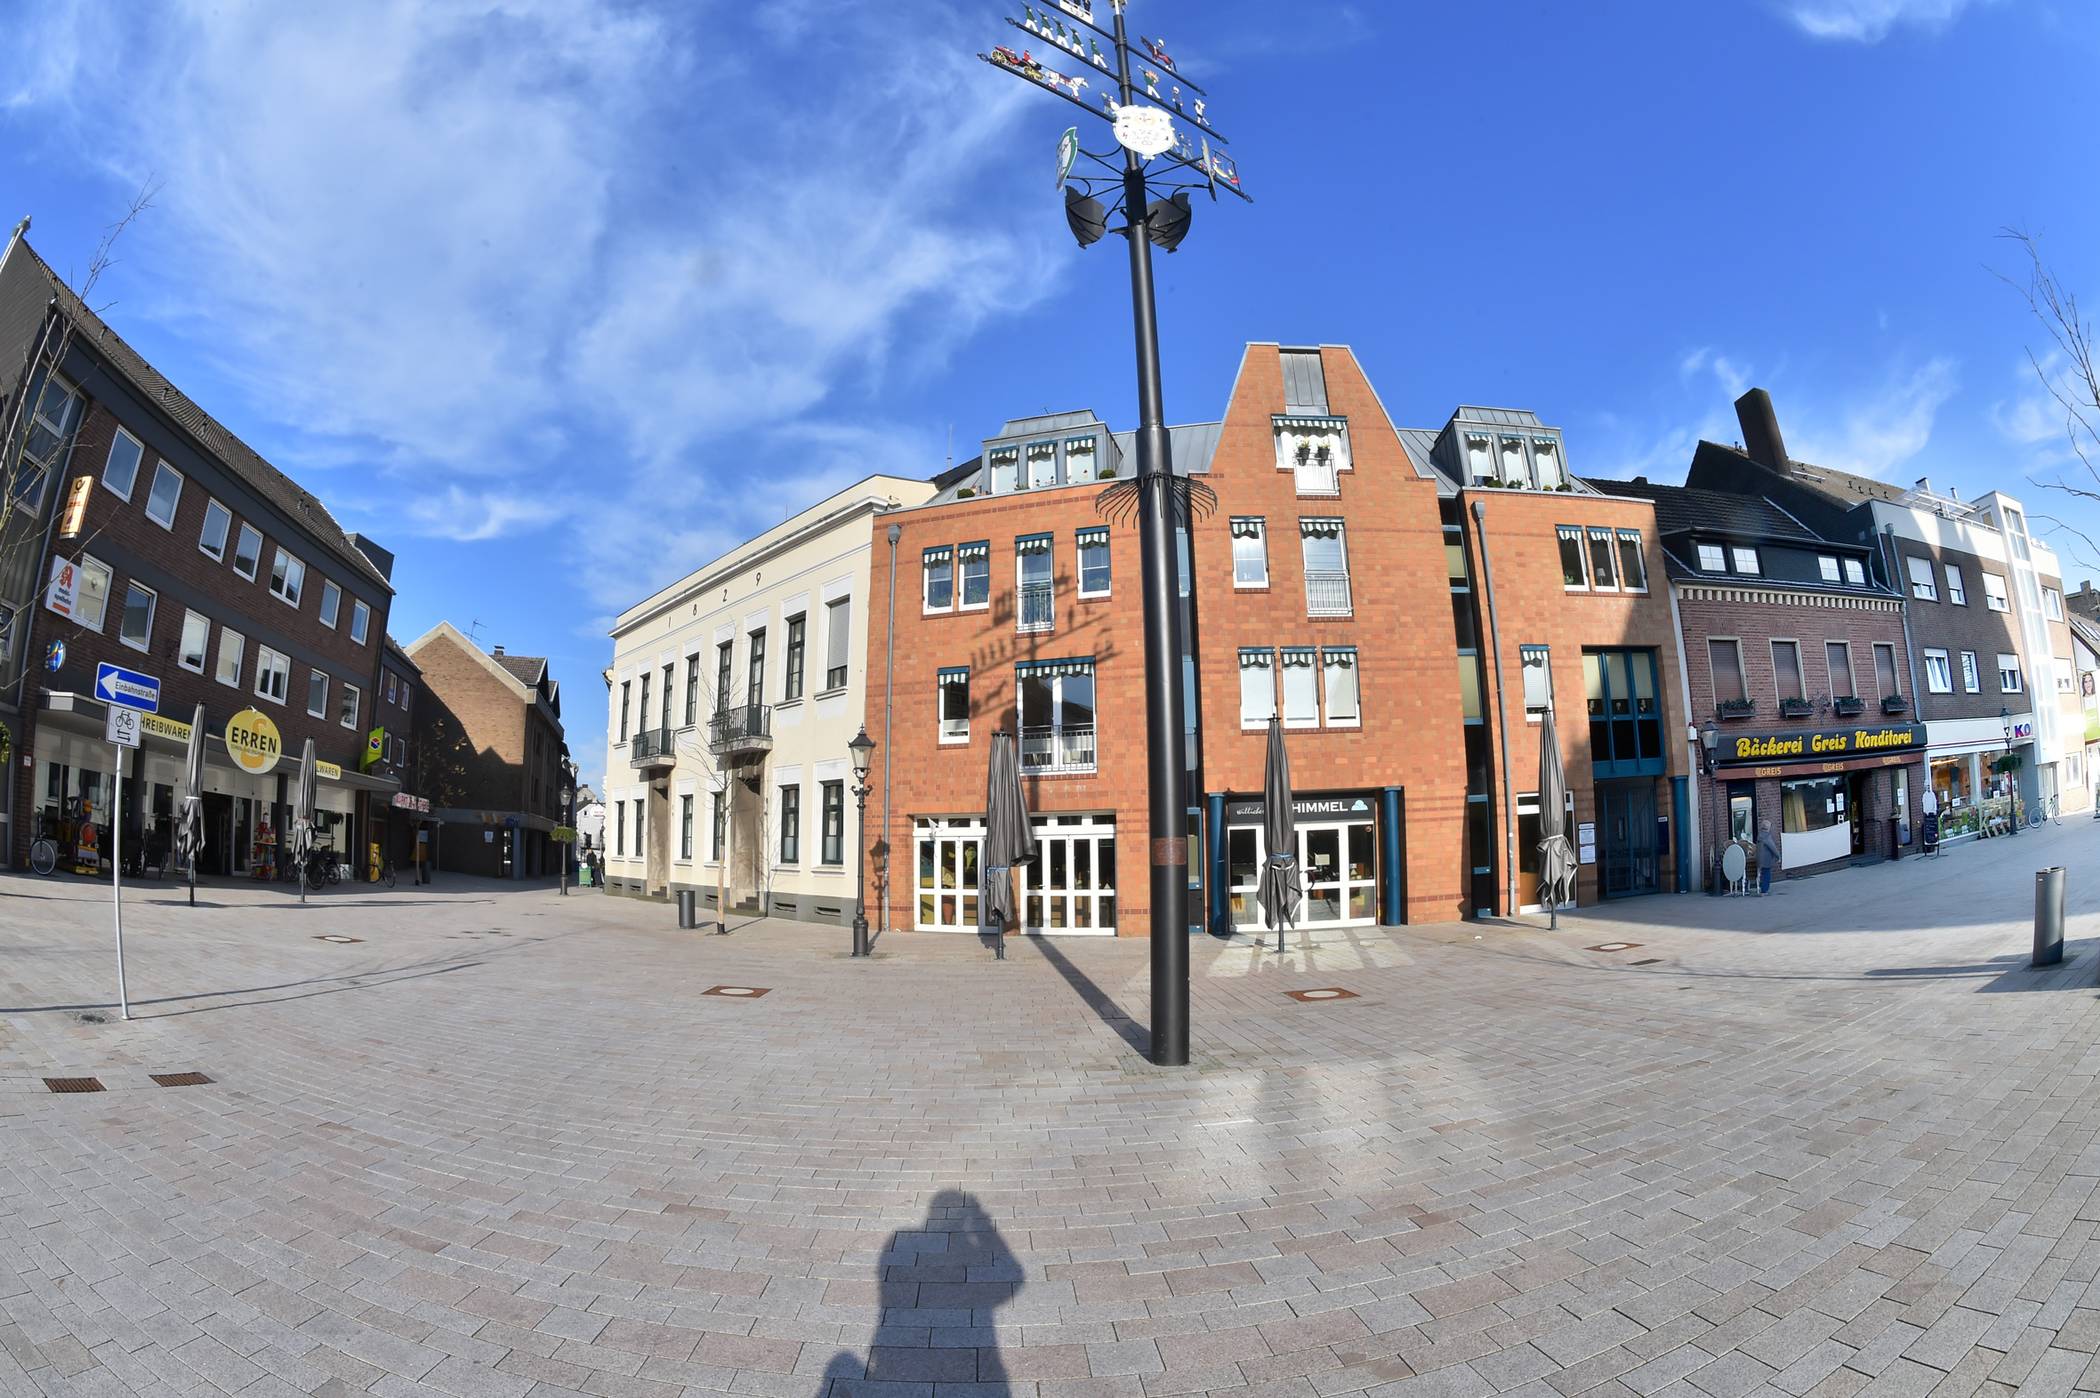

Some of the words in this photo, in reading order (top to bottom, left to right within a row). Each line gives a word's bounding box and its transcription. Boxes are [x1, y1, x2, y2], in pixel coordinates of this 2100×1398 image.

[668, 572, 762, 628] 1829
[115, 681, 155, 700] Einbahnstraße
[141, 716, 191, 740] HREIBWAREN
[231, 726, 277, 754] ERREN
[1736, 736, 1803, 758] Bäckerei
[1811, 734, 1847, 752] Greis
[1854, 729, 1912, 749] Konditorei
[316, 765, 339, 778] LWAREN
[1292, 801, 1348, 814] HIMMEL
